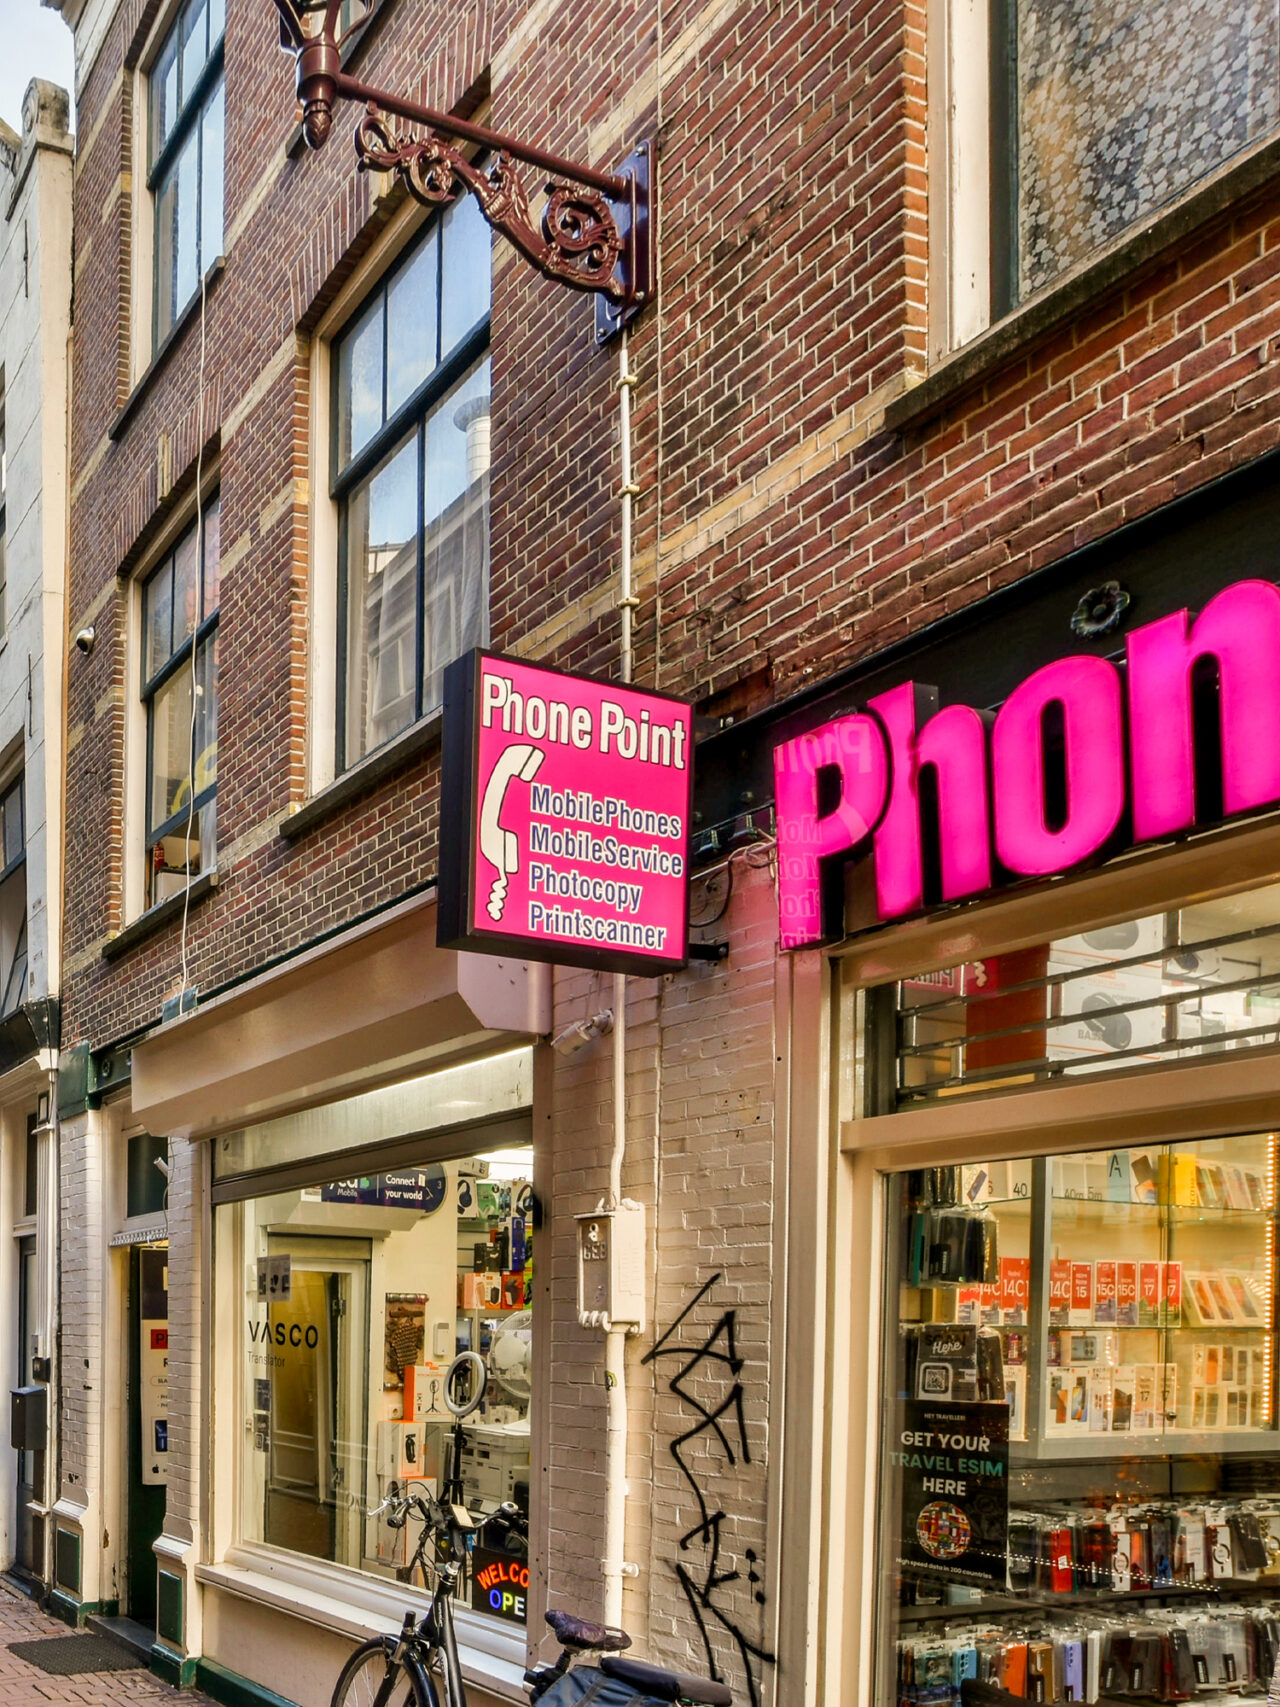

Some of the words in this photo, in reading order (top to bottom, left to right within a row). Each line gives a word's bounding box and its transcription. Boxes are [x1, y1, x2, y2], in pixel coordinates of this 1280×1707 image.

[482, 672, 592, 750] Phone
[599, 700, 686, 770] Point
[774, 579, 1280, 950] Phon
[530, 782, 681, 839] MobilePhones
[530, 822, 683, 878] MobileService
[529, 862, 643, 913] Photocopy
[528, 901, 667, 950] Printscanner
[385, 1174, 415, 1187] Connect
[385, 1190, 402, 1199] your
[402, 1190, 423, 1200] world
[1003, 1279, 1025, 1297] 14C
[1049, 1281, 1071, 1298] 14C
[1075, 1286, 1087, 1298] 15
[1097, 1284, 1115, 1296] 15C
[1118, 1284, 1136, 1296] 15C
[1144, 1284, 1155, 1296] 17
[248, 1320, 318, 1349] VASCO
[932, 1341, 963, 1355] Here
[247, 1351, 285, 1367] Translator
[900, 1431, 934, 1448] GET
[938, 1433, 991, 1453] YOUR
[889, 1451, 954, 1472] TRAVEL
[958, 1458, 1004, 1477] ESIM
[922, 1477, 967, 1497] HERE
[962, 1569, 993, 1579] countries
